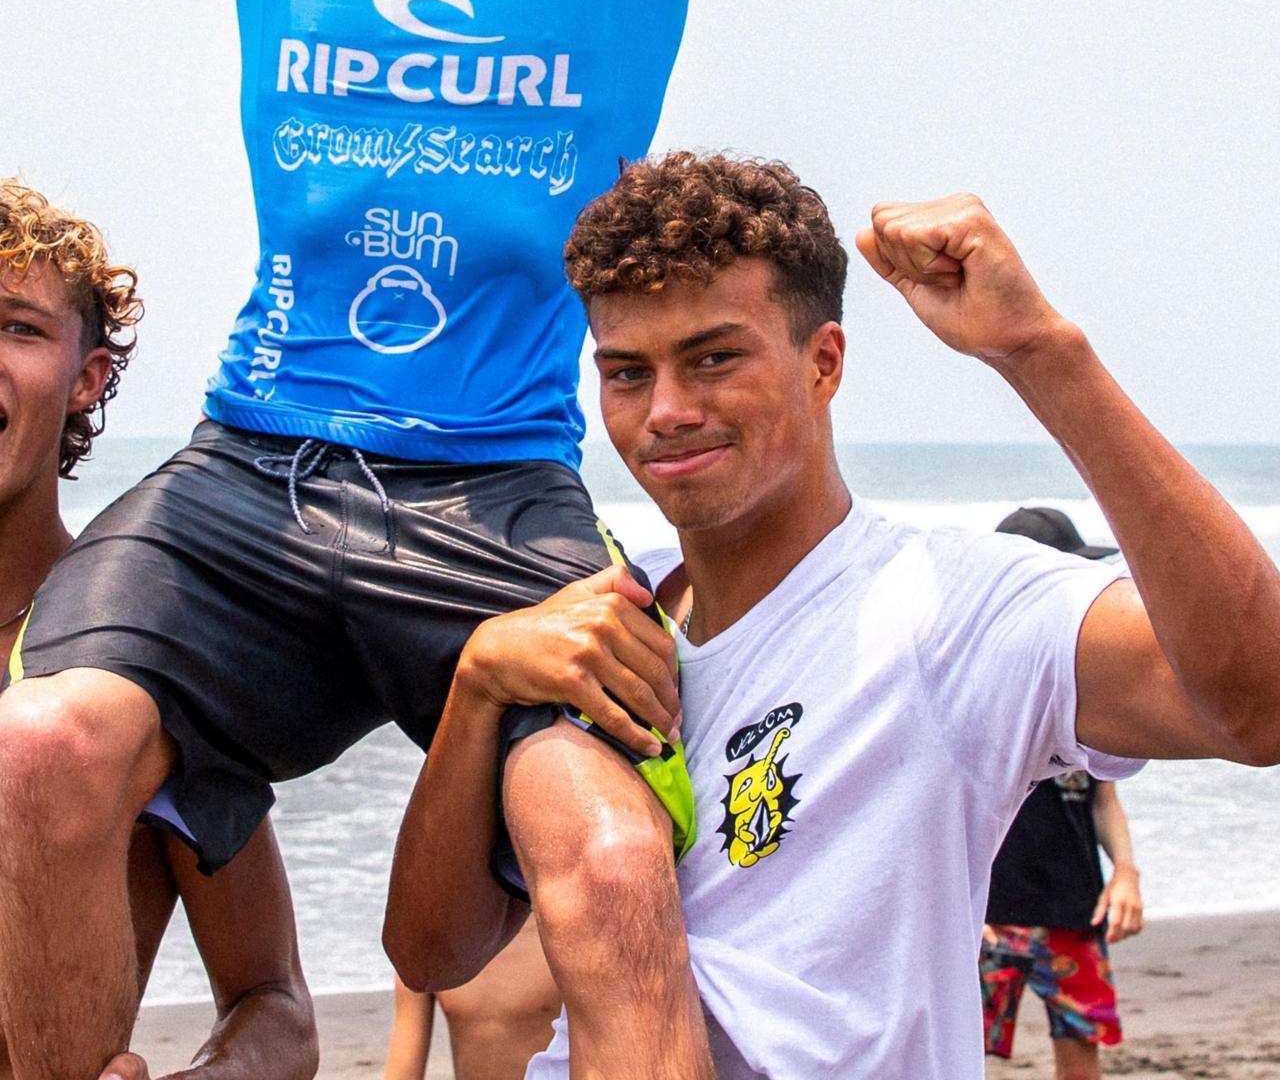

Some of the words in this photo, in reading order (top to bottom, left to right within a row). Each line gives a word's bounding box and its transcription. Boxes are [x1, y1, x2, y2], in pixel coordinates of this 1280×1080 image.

[276, 38, 380, 97] RIP
[385, 52, 583, 108] CURL
[268, 253, 296, 311] RIP
